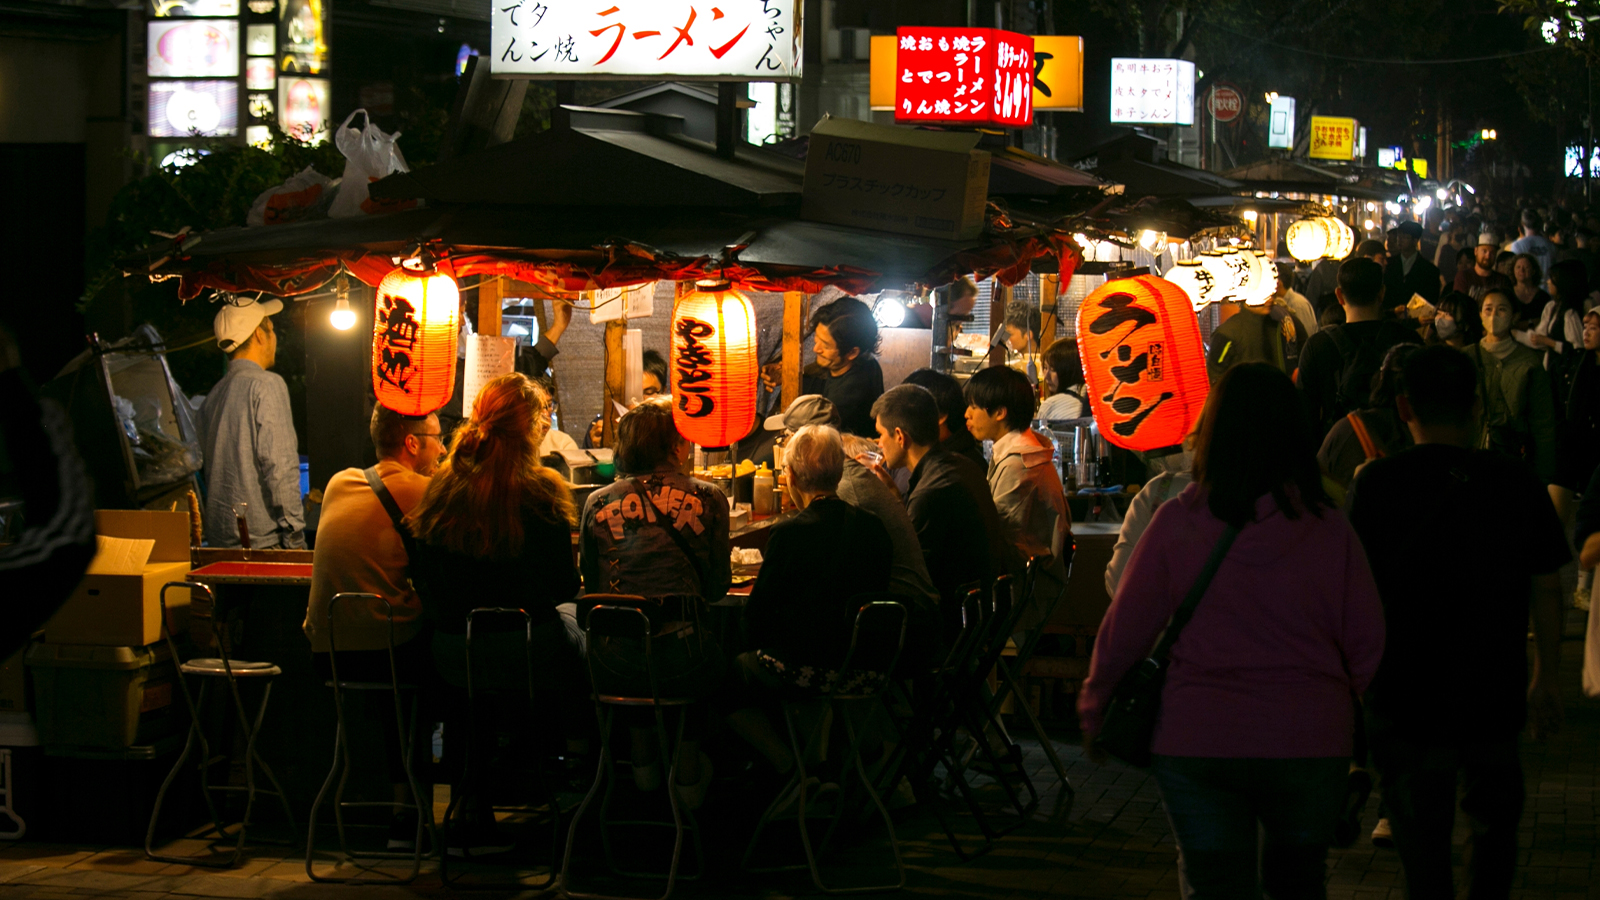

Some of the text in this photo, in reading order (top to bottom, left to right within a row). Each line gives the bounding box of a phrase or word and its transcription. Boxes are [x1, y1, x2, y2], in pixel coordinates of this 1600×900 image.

[501, 1, 524, 62] でん
[529, 2, 550, 62] タン
[554, 34, 578, 62] 焼
[588, 5, 751, 66] ラーメン
[755, 0, 784, 70] ちゃん
[900, 35, 916, 114] 焼とり
[917, 36, 933, 114] おでん
[934, 36, 951, 115] もつ焼
[953, 35, 970, 114] 焼ラーメン
[970, 36, 986, 114] ラーメン
[1127, 63, 1137, 118] 明太子
[1140, 63, 1149, 119] 牛タン
[1150, 63, 1161, 119] おでん
[1163, 63, 1172, 119] ラーメン
[823, 173, 947, 202] プラスチックカップ
[676, 318, 714, 418] やきとり
[1089, 294, 1174, 437] ラーメン
[595, 485, 706, 541] POWER
